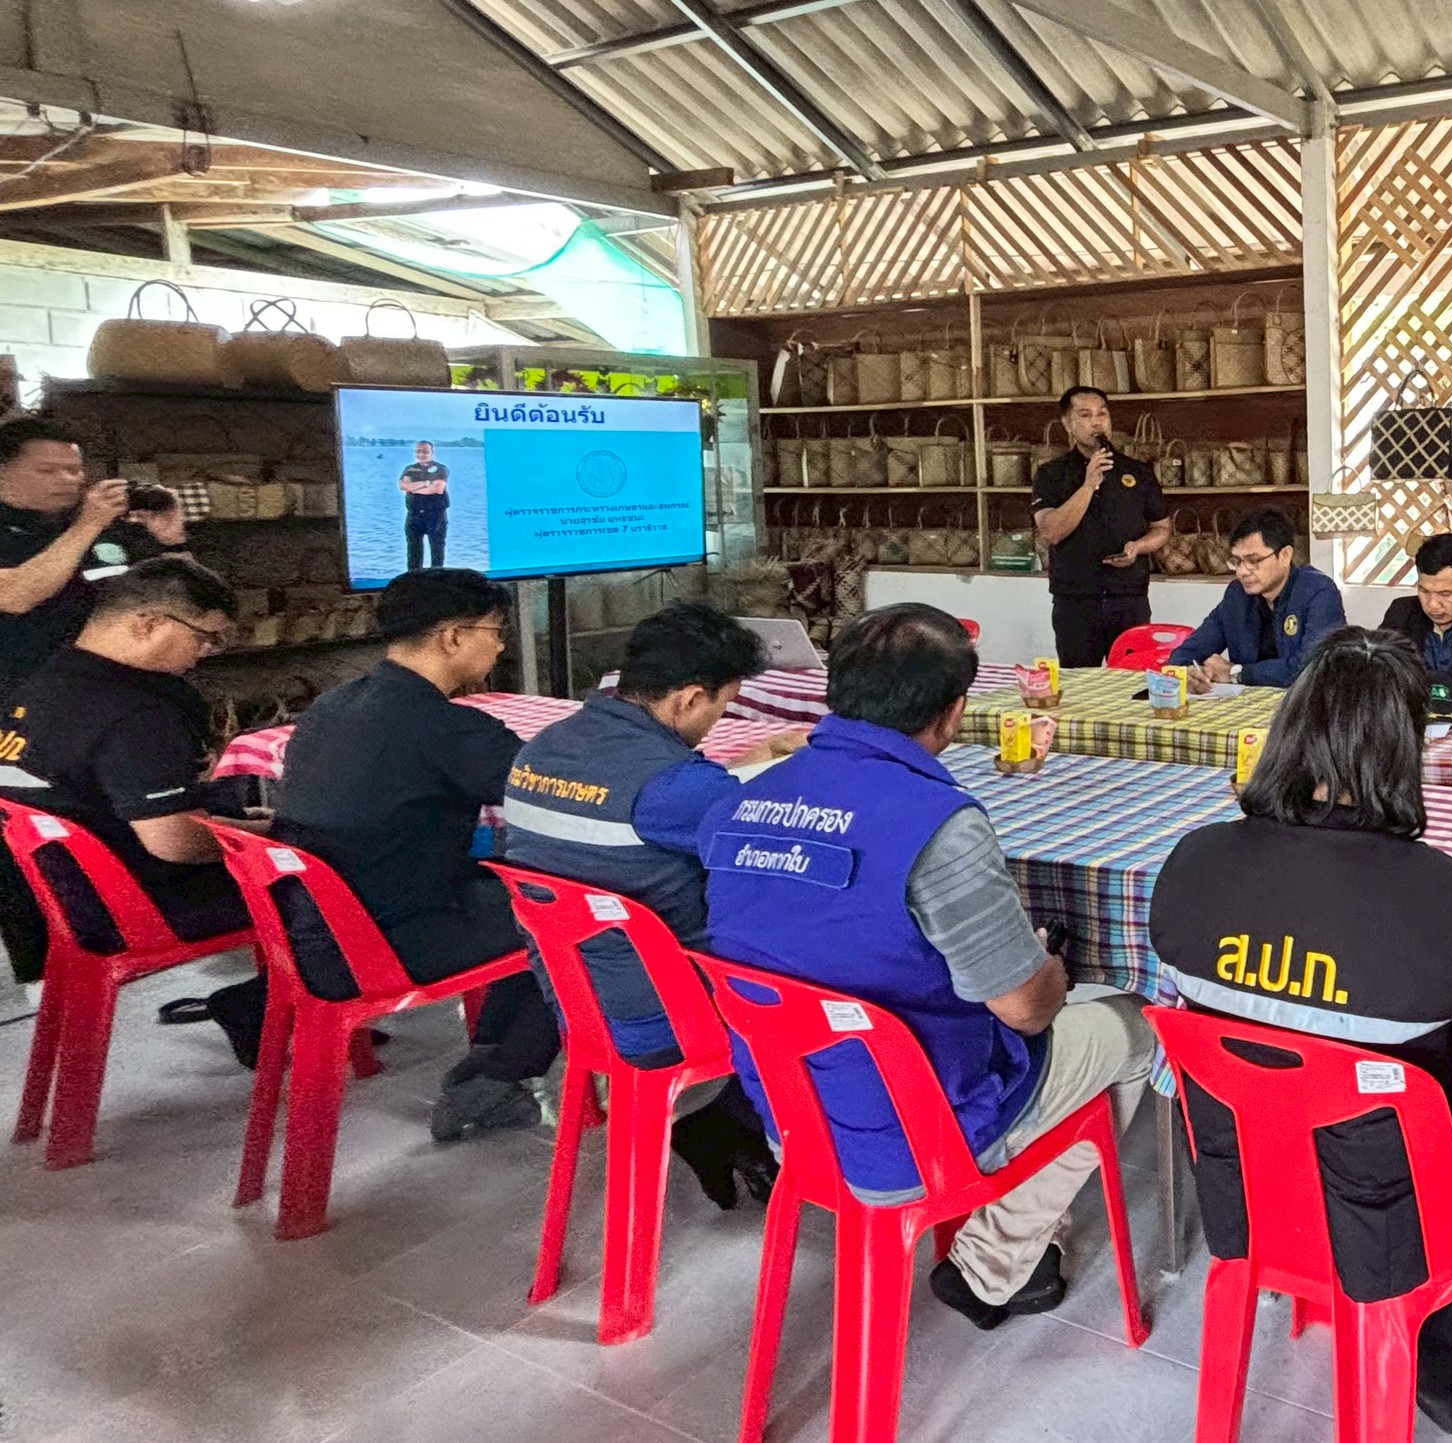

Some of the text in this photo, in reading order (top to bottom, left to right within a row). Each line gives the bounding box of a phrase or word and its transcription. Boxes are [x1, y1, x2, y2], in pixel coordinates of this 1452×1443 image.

[474, 402, 605, 424] ยินดีต้อนรับ
[731, 796, 853, 834] กรมการปกครอง
[735, 844, 811, 873] อำเภอตากใบ
[1217, 934, 1348, 1005] ส.ป.ก.
